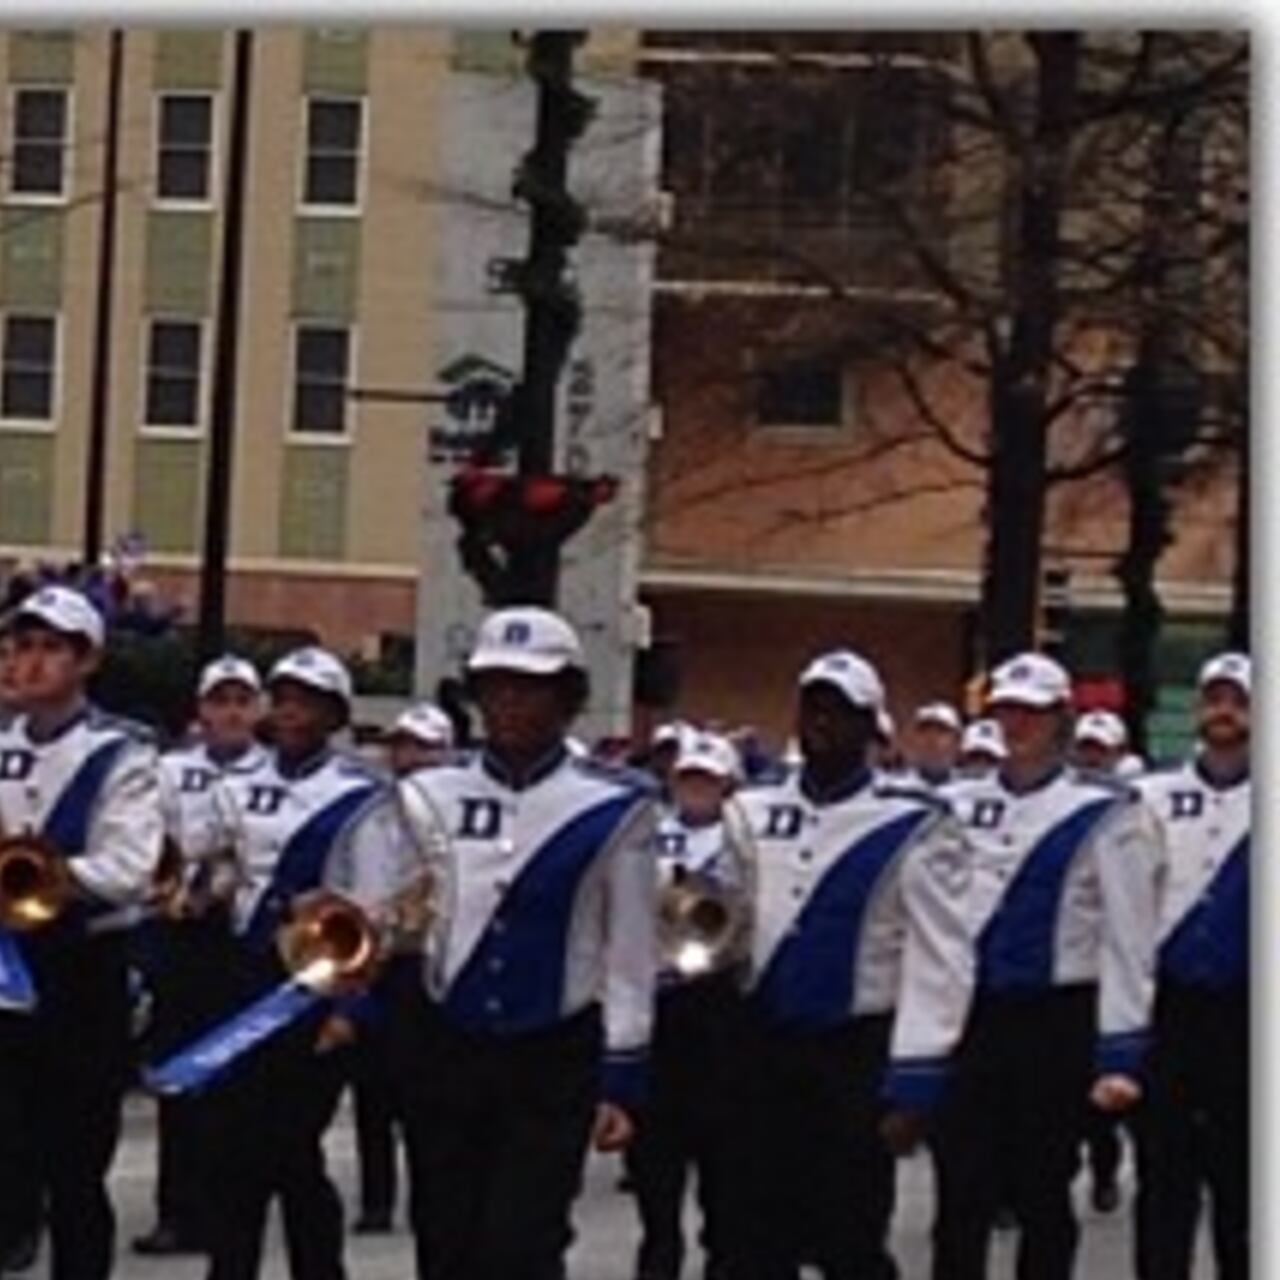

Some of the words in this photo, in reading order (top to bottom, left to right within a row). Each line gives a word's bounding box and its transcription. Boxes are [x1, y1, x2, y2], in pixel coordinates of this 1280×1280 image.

[247, 785, 286, 815] D
[971, 799, 1005, 829] D
[1171, 791, 1203, 819] D
[459, 798, 503, 841] D
[762, 804, 802, 840] D
